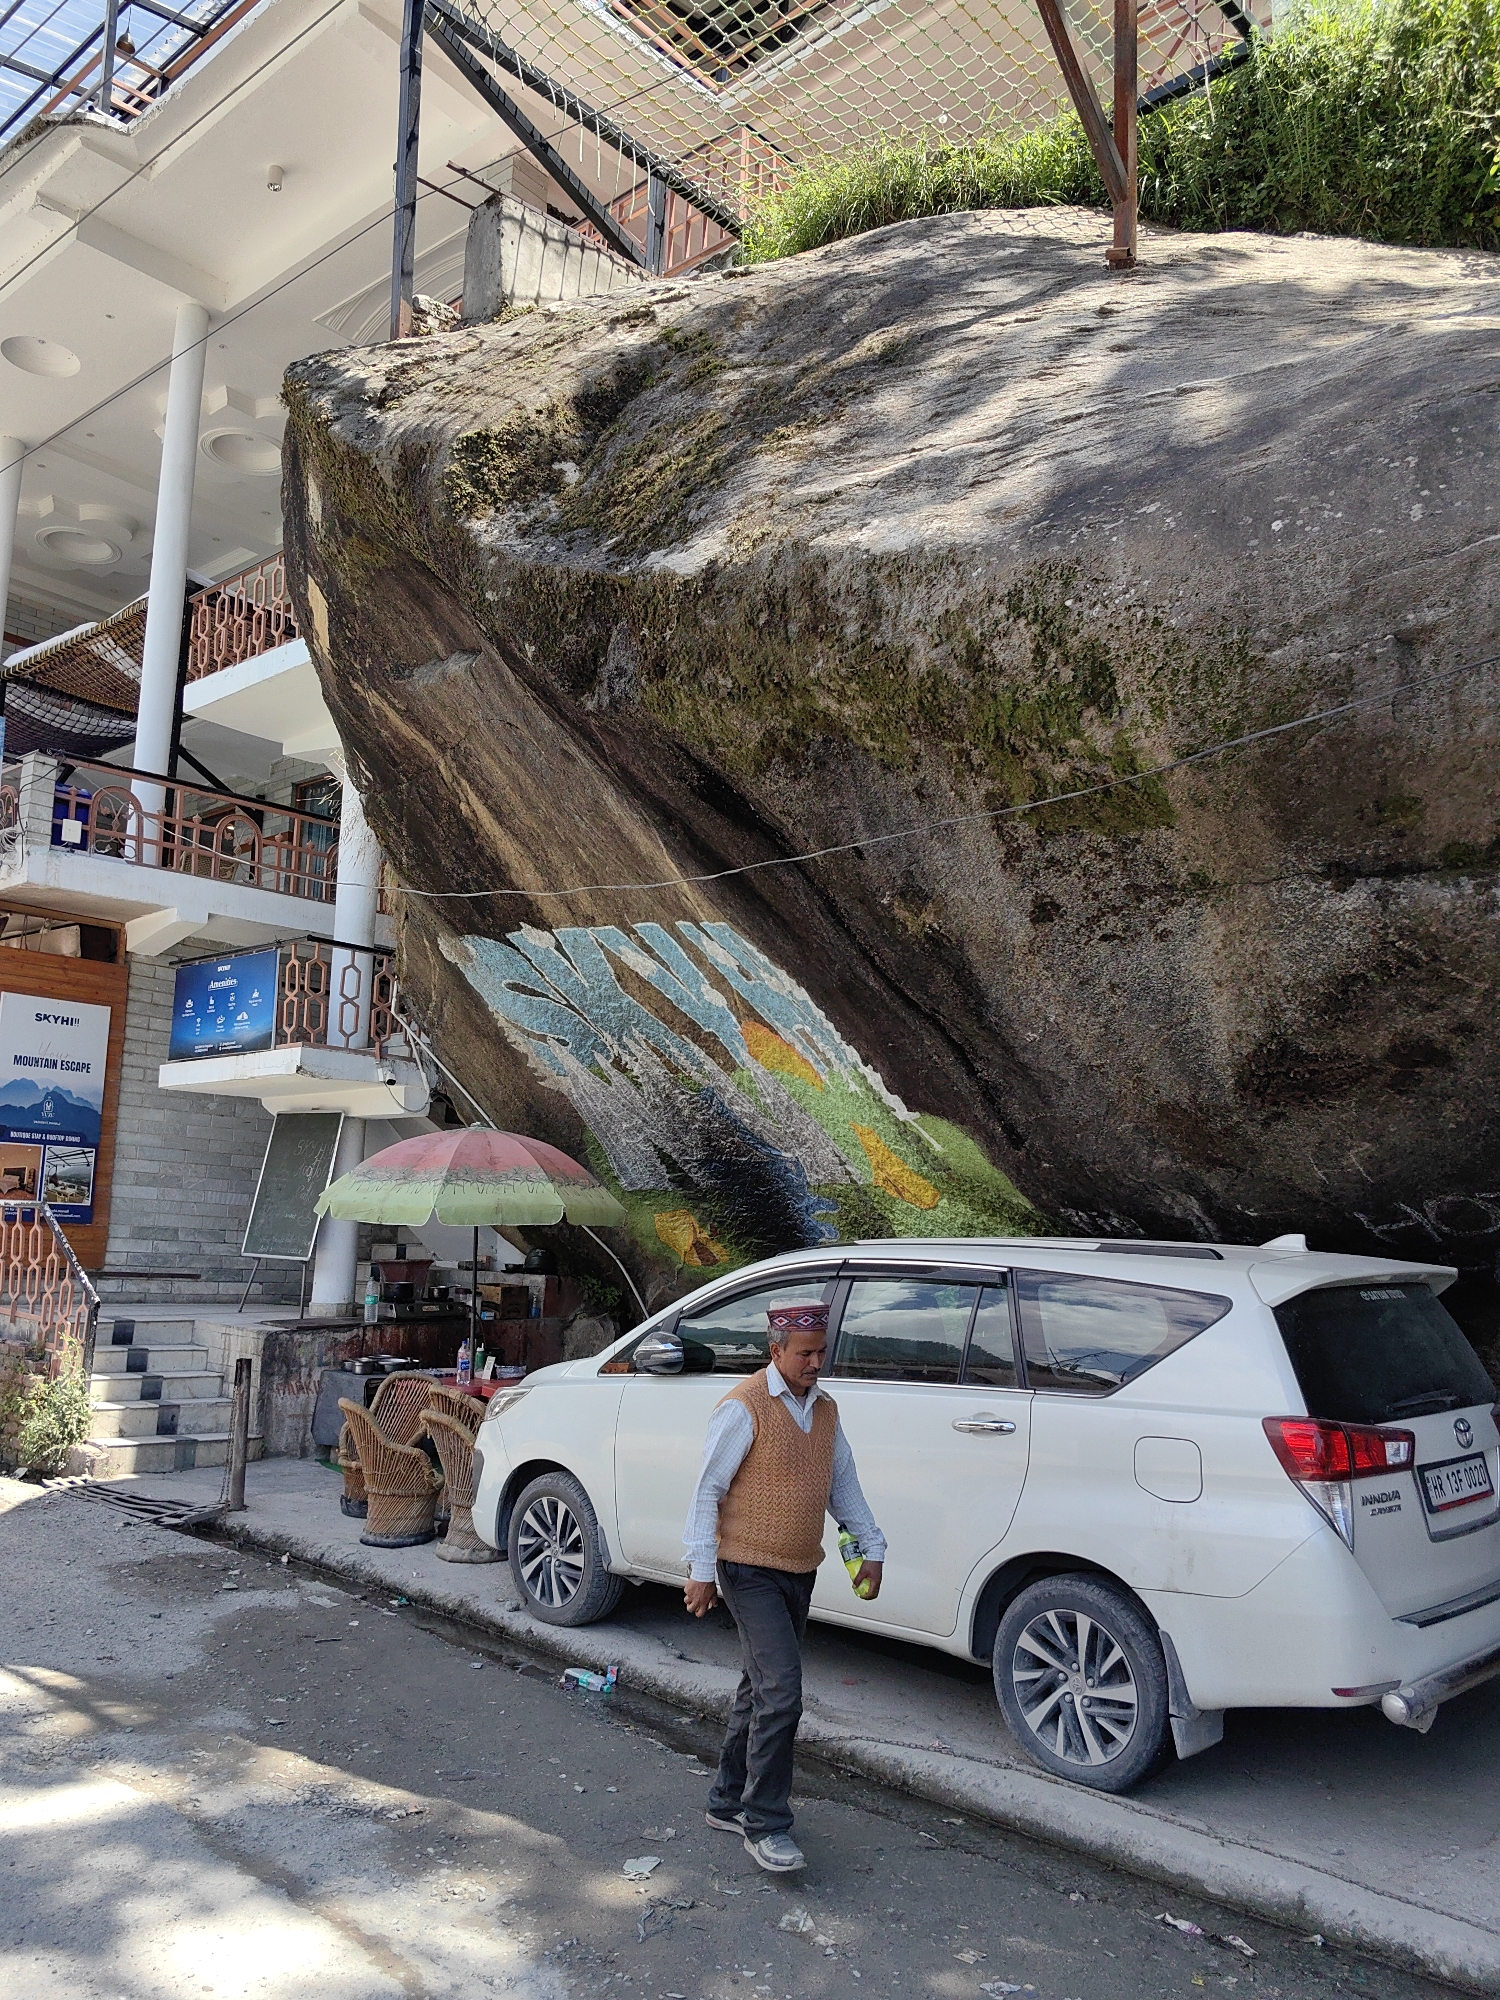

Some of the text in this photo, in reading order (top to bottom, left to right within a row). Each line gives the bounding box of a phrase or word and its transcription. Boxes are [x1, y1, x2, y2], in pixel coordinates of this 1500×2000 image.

[210, 977, 237, 989] Amenities
[38, 1041, 71, 1060] Your
[13, 1054, 91, 1074] MOUNTAIN ESCAPE
[10, 1131, 31, 1139] BOUTIQUE
[31, 1132, 42, 1140] STAY
[1431, 1463, 1487, 1499] HR 13F 0020
[1361, 1490, 1401, 1506] INNOVA
